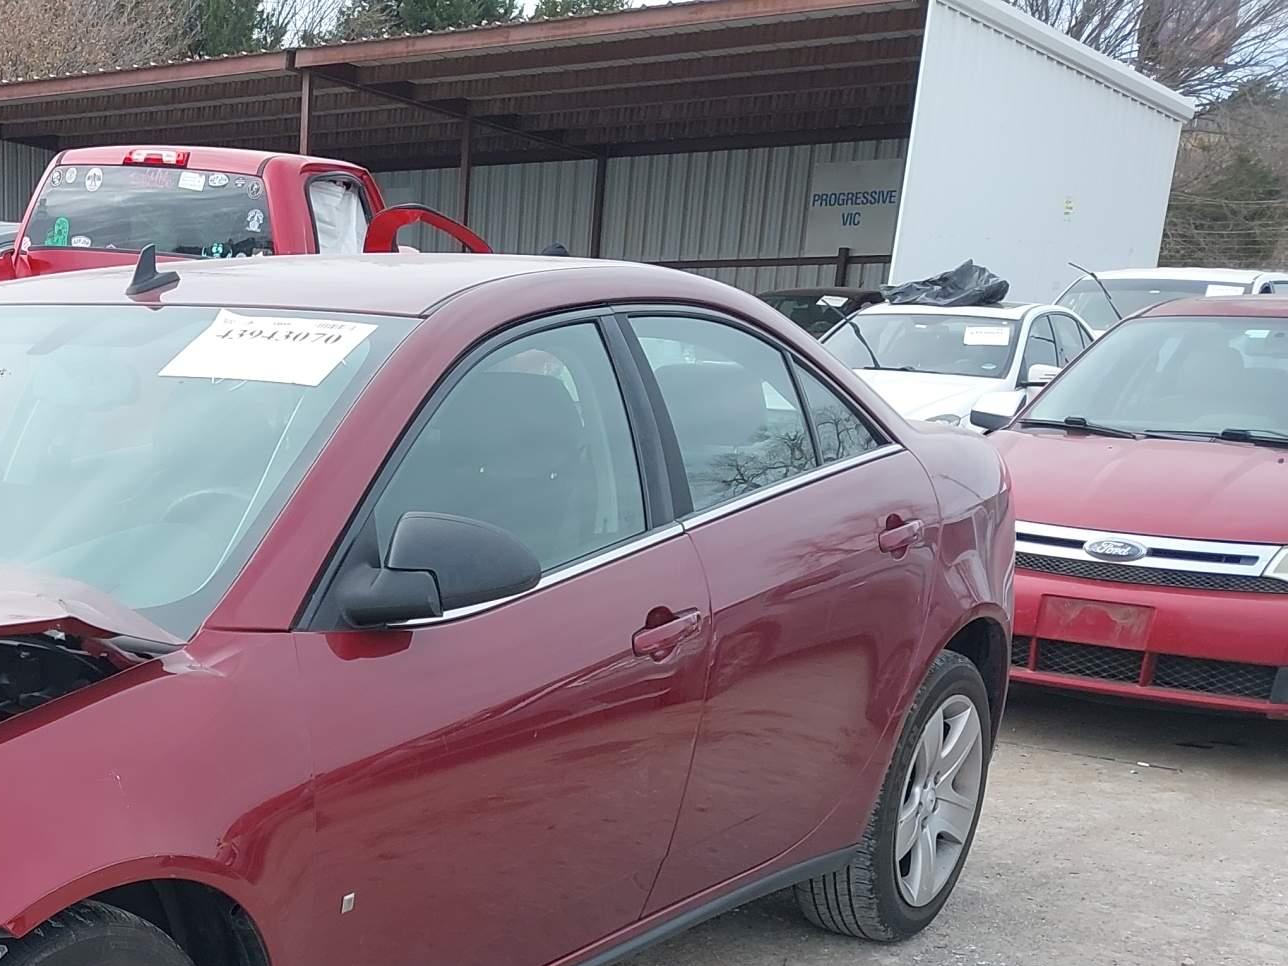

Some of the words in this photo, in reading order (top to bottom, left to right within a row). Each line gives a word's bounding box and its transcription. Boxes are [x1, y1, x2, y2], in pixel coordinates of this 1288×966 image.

[812, 189, 897, 207] PROGRESSIVE
[841, 211, 861, 226] VIC
[215, 328, 343, 344] 43943070
[1096, 541, 1132, 556] Ford
